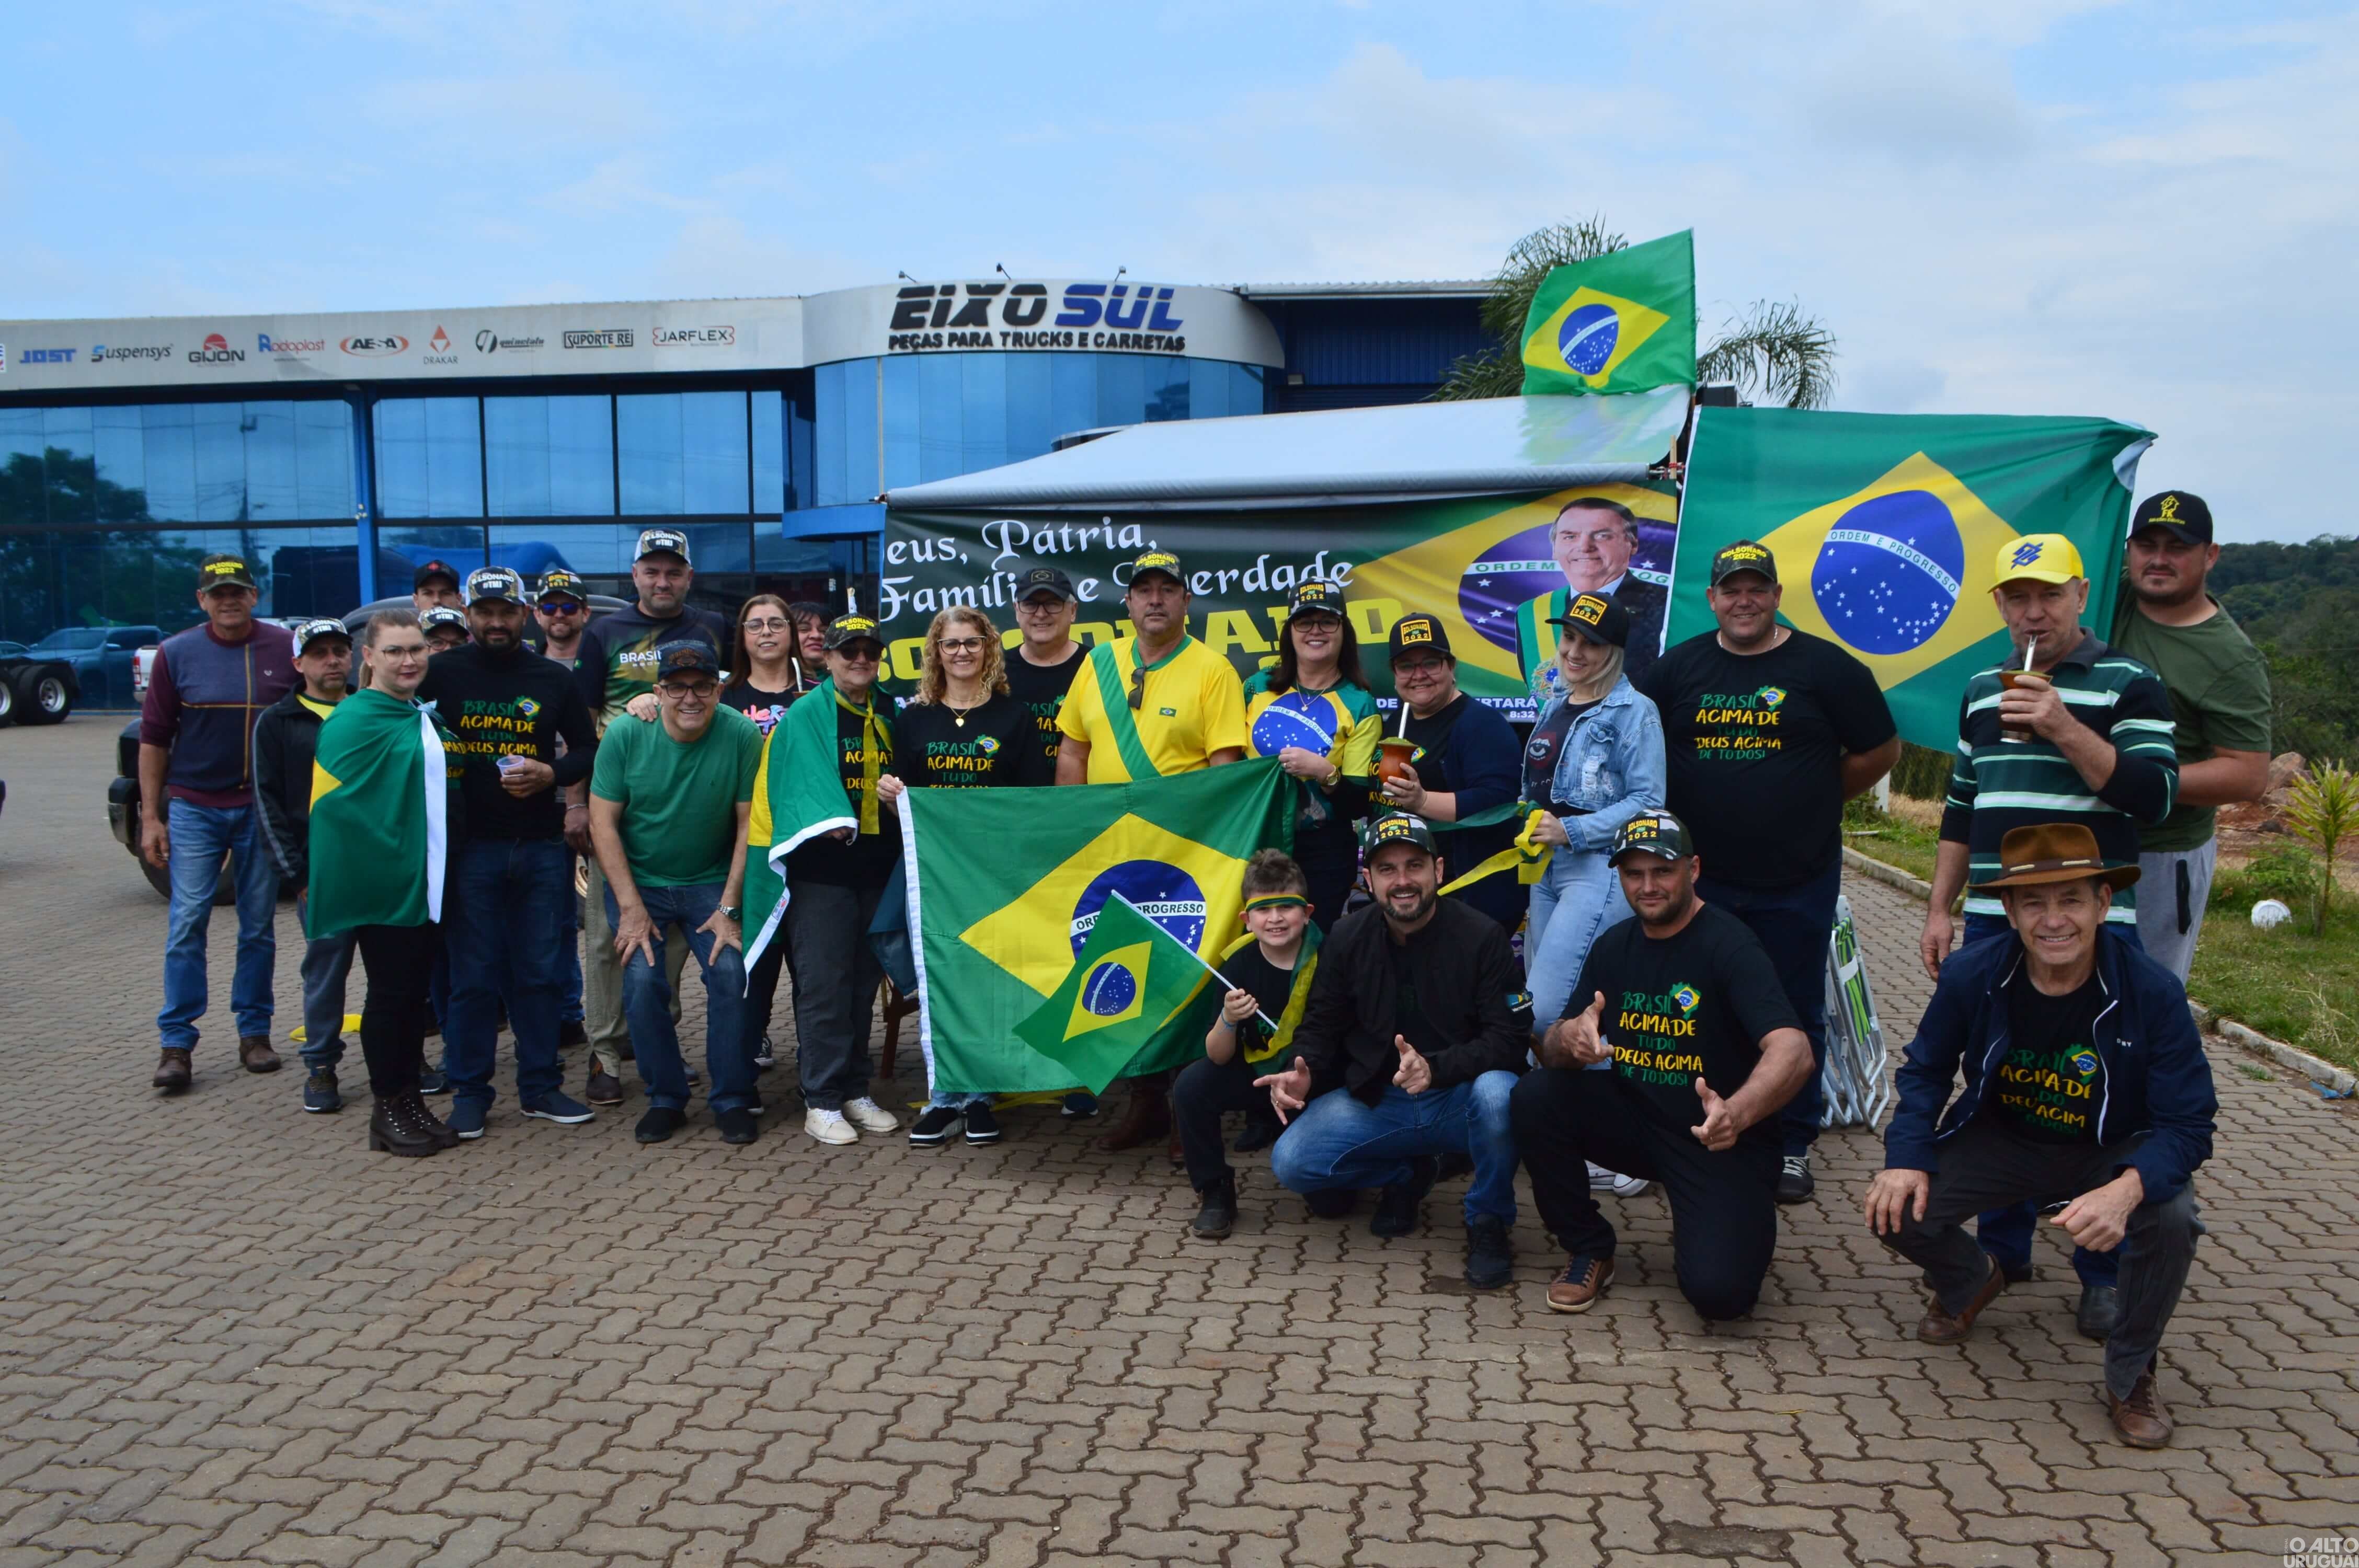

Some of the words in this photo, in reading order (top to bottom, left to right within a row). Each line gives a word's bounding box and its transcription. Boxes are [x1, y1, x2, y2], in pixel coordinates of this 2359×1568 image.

[890, 283, 1046, 329] EIXO
[1055, 284, 1184, 330] SUL
[258, 333, 325, 354] Rodoplast
[567, 333, 614, 347] SUPORTE
[659, 330, 727, 342] JARFLEX
[889, 332, 943, 352] PEÇAS
[947, 332, 993, 348] PARA
[1000, 331, 1073, 348] TRUCKS
[1078, 332, 1089, 347] E
[1094, 332, 1185, 352] CARRETAS
[20, 348, 76, 363] JOST
[91, 344, 171, 362] Suspensys
[189, 349, 245, 363] GIJON
[423, 356, 458, 364] DRAKAR
[883, 537, 967, 565] eus,
[982, 516, 1157, 570] Pátria,
[1721, 546, 1766, 558] BOLSONARO
[1136, 554, 1175, 566] BOLSONARO
[1475, 562, 1556, 572] ORDEM
[1830, 531, 1870, 542] ORDEM
[1876, 537, 1884, 545] E
[1889, 541, 1956, 593] PROGRESSO
[880, 571, 1016, 622] Famíli
[1077, 578, 1099, 602] e
[1574, 608, 1597, 620] 2022
[836, 617, 874, 628] BOLSONARO
[462, 700, 518, 717] BRASIL
[1698, 694, 1759, 709] BRASIL
[1267, 706, 1290, 714] ORDEM
[1696, 709, 1754, 725] ACIMA
[1755, 711, 1781, 725] DE
[460, 715, 512, 731] ACIMA
[514, 720, 536, 733] DE
[499, 742, 537, 756] ACIMA
[925, 741, 978, 756] BRASIL
[1694, 736, 1730, 748] DEUS
[1734, 736, 1781, 750] ACIMA
[1698, 748, 1713, 759] DE
[928, 755, 973, 771] ACIMA
[974, 758, 994, 771] DE
[941, 772, 977, 783] TUDO
[1379, 819, 1408, 832] BOLSONARO
[1628, 819, 1657, 833] BOLSONARO
[1381, 829, 1409, 839] 2022
[1628, 831, 1657, 841] 2022
[1621, 991, 1674, 1014] BRASIL
[1619, 1011, 1670, 1035] ACIMA
[1670, 1019, 1696, 1036] DE
[1635, 1034, 1676, 1051] TUDO
[1614, 1046, 1651, 1067] DEUS
[1655, 1054, 1703, 1073] ACIMA
[1619, 1064, 1635, 1078] DE
[1641, 1068, 1688, 1087] TODOS!
[1999, 1093, 2037, 1108] DEU
[2036, 1104, 2086, 1128] ACIM
